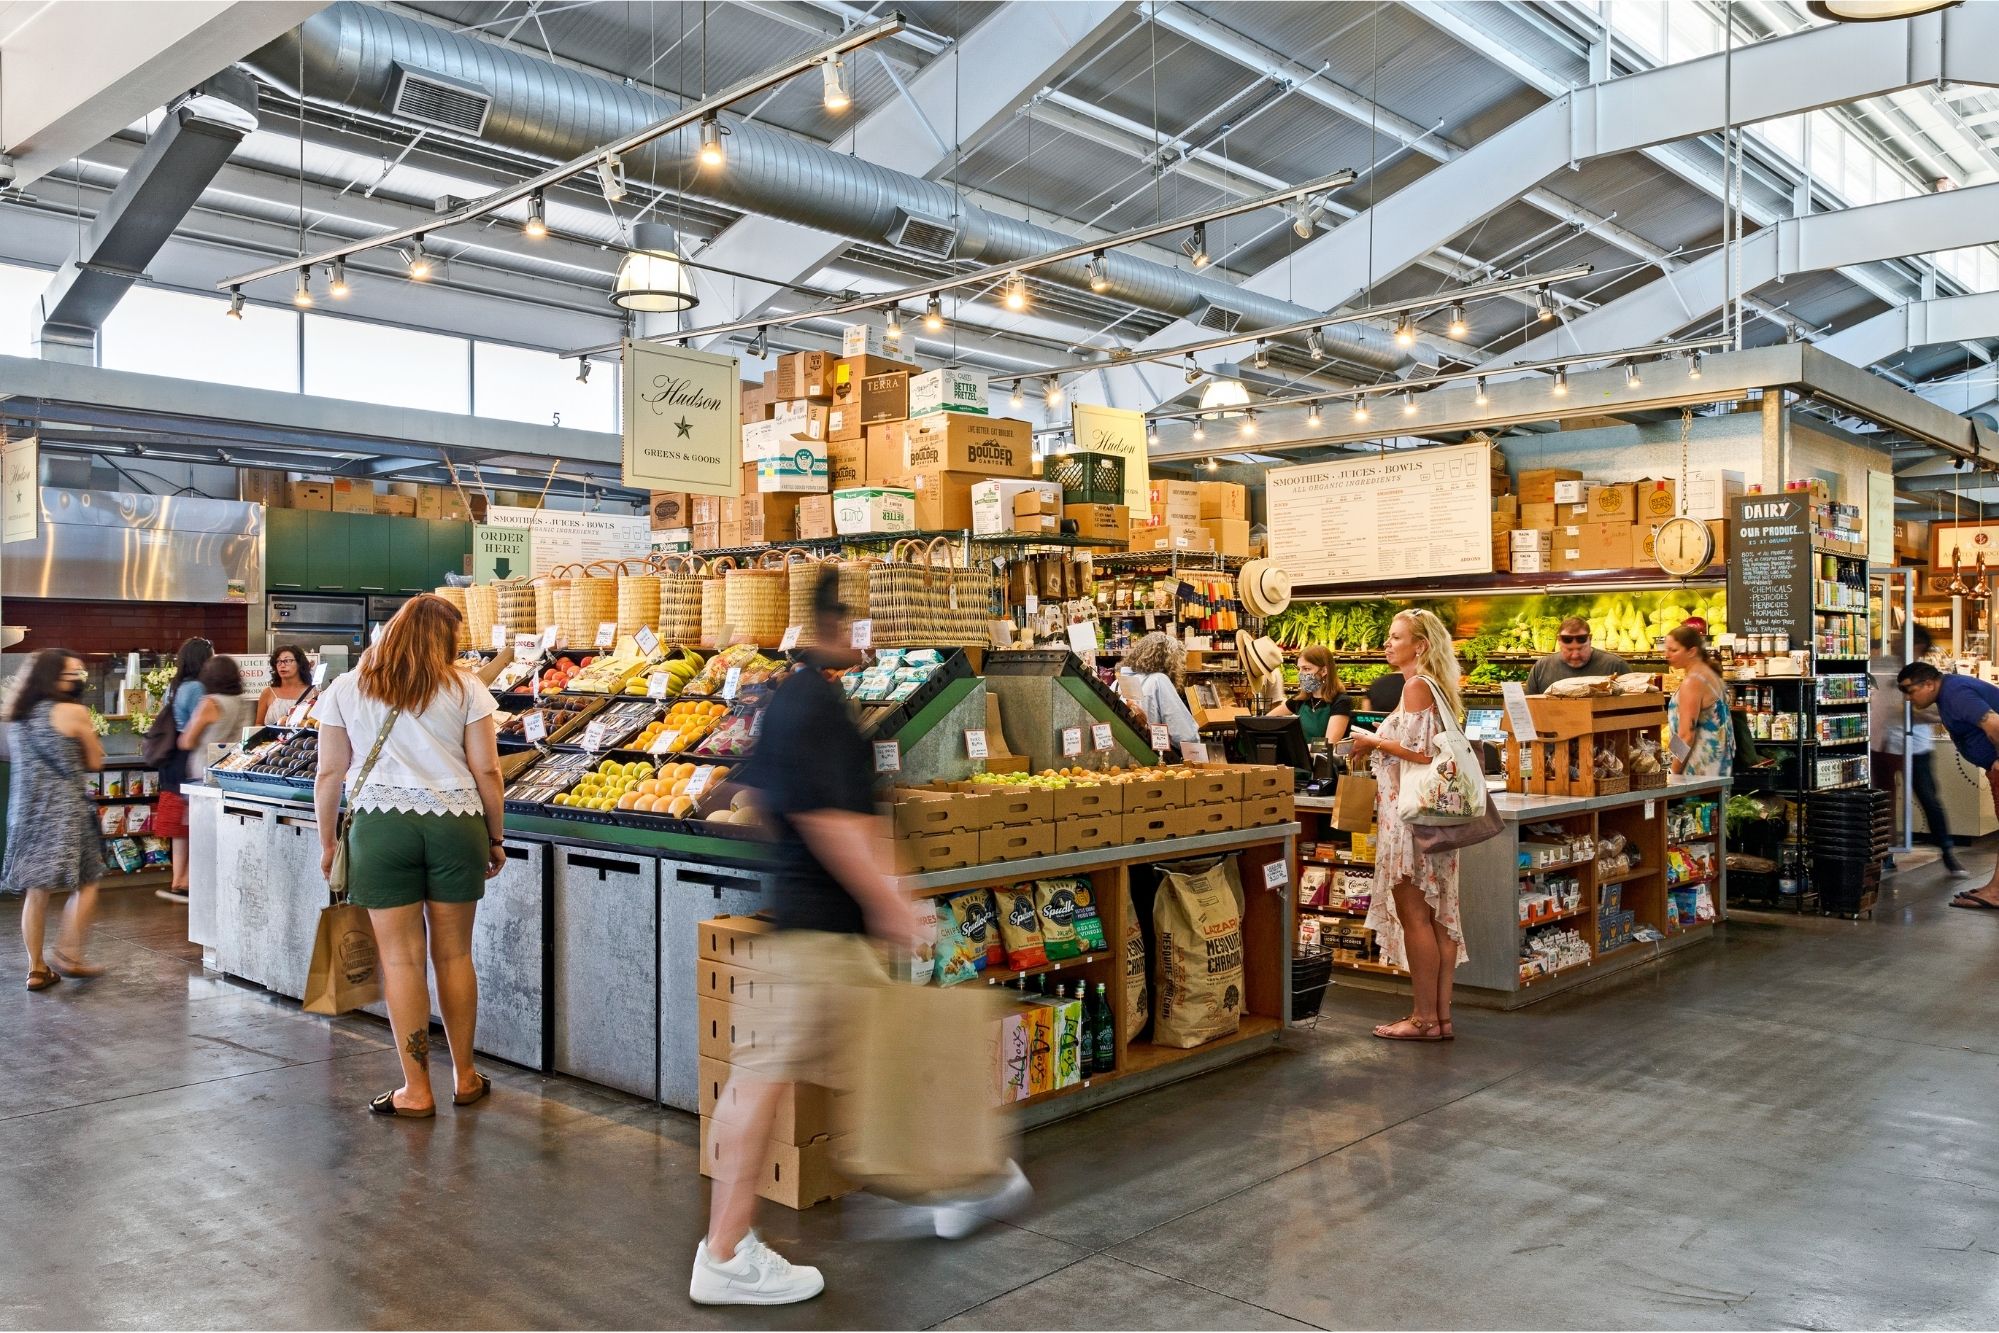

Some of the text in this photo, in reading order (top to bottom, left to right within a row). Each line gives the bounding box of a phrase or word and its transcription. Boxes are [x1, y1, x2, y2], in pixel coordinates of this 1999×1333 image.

[868, 381, 899, 392] TERRA
[954, 382, 976, 393] BETTER
[642, 374, 721, 416] Hudson
[954, 390, 977, 400] PRETZEL
[553, 412, 560, 427] 5
[1086, 428, 1137, 455] Hudson
[644, 448, 680, 461] GREENS
[691, 454, 720, 464] GOODS
[911, 449, 938, 466] BOULDER
[968, 445, 1012, 466] BOULDER
[1273, 462, 1423, 487] SMOOTHIES JUICES BOWLS
[1292, 475, 1401, 494] ALL ORGANIC INGREDIENTS
[883, 512, 904, 521] BETTER
[1744, 503, 1790, 520] DAIRY
[494, 515, 615, 529] SMOOTHIES JUICES BOWLS
[481, 531, 524, 543] ORDER
[1740, 527, 1760, 537] OUR
[485, 544, 520, 554] HERE
[1163, 932, 1172, 977] MESQUITE
